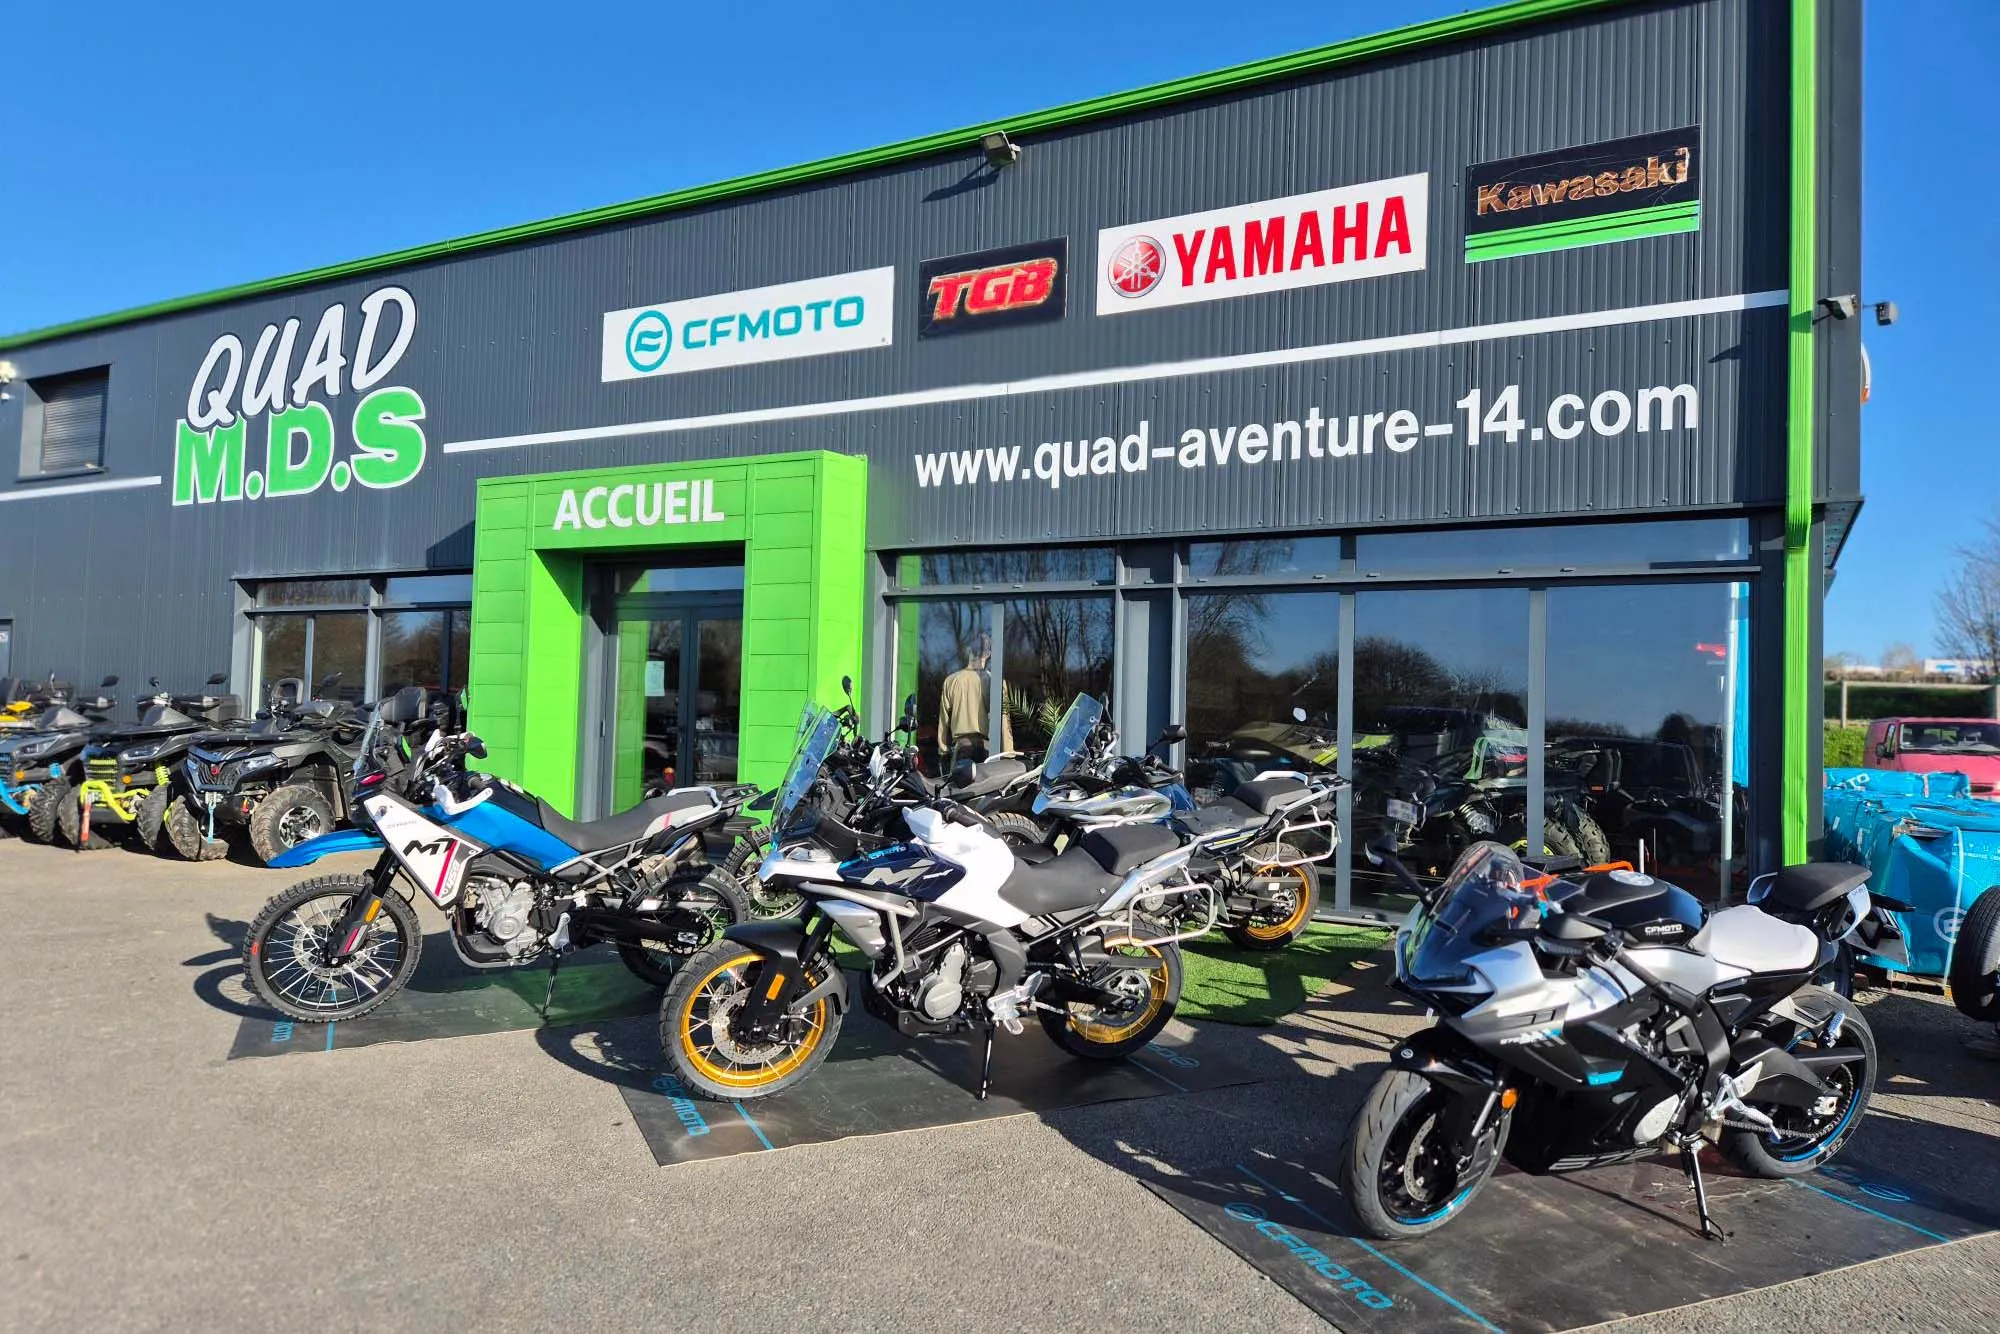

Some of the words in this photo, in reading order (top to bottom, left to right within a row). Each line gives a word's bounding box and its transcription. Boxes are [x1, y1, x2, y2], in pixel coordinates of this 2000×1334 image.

[1477, 147, 1690, 215] Kawasaki
[1173, 195, 1411, 287] YAMAHA
[683, 296, 864, 349] CFMOTO
[928, 257, 1059, 320] TGB
[187, 285, 417, 429] QUAD
[914, 382, 1698, 489] www.quad-aventure-14.com
[553, 479, 725, 531] ACCUEIL
[1256, 1219, 1394, 1310] CFMOTO
